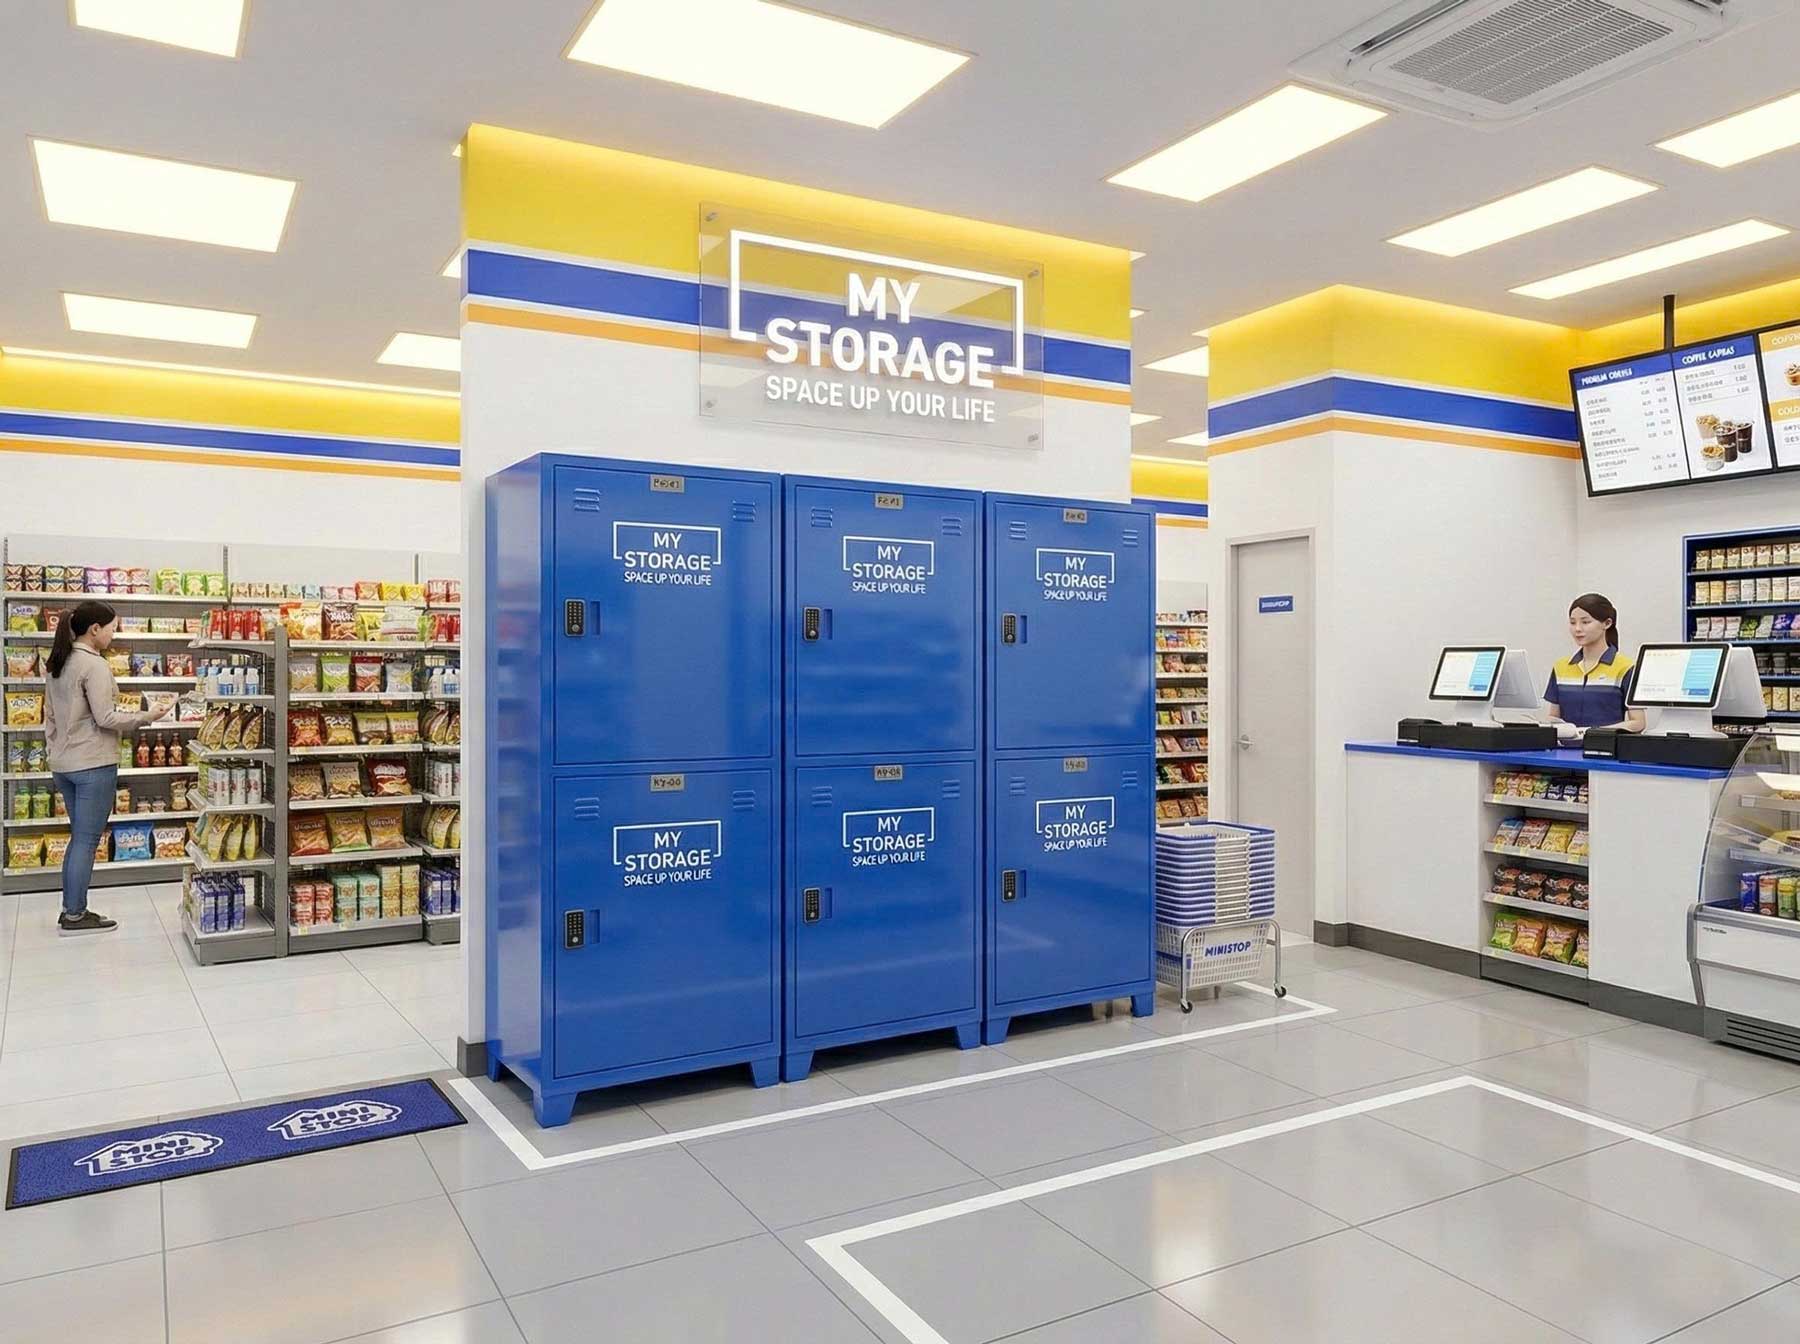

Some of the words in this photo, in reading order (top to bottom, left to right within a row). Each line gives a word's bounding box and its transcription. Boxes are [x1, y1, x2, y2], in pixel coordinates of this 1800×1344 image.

[849, 273, 920, 323] MY
[766, 317, 995, 389] STORAGE
[766, 375, 843, 407] SPACE
[850, 385, 880, 411] UP
[887, 389, 945, 418] YOUR
[952, 395, 995, 422] LIFE
[654, 532, 682, 549] MY
[624, 551, 711, 571] STORAGE
[877, 546, 902, 562] MY
[852, 563, 925, 580] STORAGE
[1065, 557, 1086, 571] MY
[624, 571, 653, 583] SPACE
[654, 573, 667, 584] UP
[668, 573, 693, 585] YOUR
[693, 574, 712, 586] LIFE
[878, 582, 889, 593] UP
[1044, 573, 1107, 589] STORAGE
[1065, 805, 1086, 820] MY
[878, 816, 902, 832] MY
[1044, 821, 1107, 839] STORAGE
[654, 831, 682, 849] MY
[852, 833, 925, 853] STORAGE
[624, 849, 712, 872] STORAGE
[878, 853, 889, 865] UP
[624, 873, 654, 887] SPACE
[654, 872, 668, 884] UP
[668, 870, 693, 883] YOUR
[693, 868, 712, 881] LIFE
[1204, 941, 1251, 957] MINISTOP
[300, 1106, 370, 1124] MINI
[300, 1113, 376, 1133] STOP
[110, 1145, 195, 1168] STOP
[112, 1138, 189, 1158] MINI
